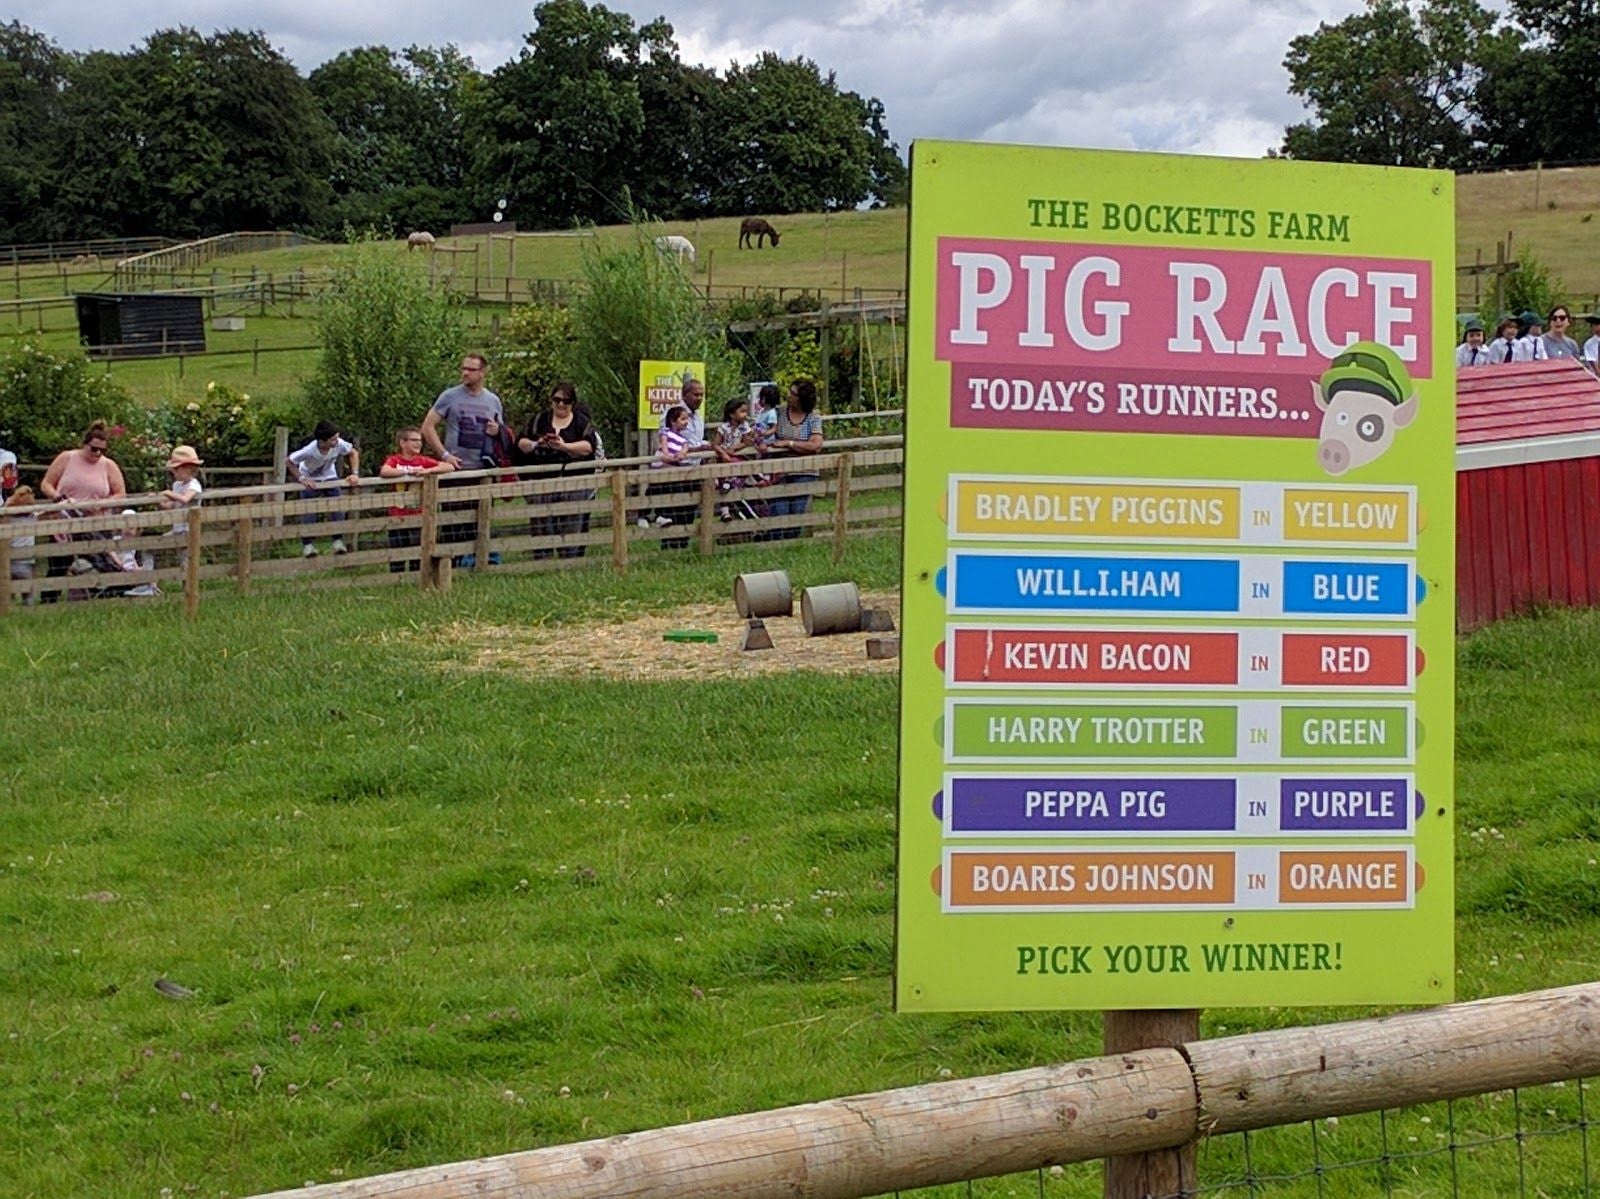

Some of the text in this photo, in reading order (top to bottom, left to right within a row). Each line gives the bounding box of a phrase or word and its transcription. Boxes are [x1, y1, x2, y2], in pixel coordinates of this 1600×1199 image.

[1028, 199, 1350, 242] THE BOCKETTS FARM
[949, 252, 1418, 361] PIG RACE
[648, 388, 681, 400] KITCH
[968, 378, 1310, 421] TODAY'S RUNNERS...
[975, 495, 1398, 530] BRADLEY PIGGINS IN YELLOW
[1016, 568, 1380, 601] WILL.I.HAM IN BLUE
[1005, 642, 1370, 673] KEVIN BACON IN RED
[988, 717, 1386, 745] HARRY TROTTER IN GREEN
[1025, 791, 1395, 818] PEPPA PIG IN PURPLE
[972, 863, 1397, 892] BOARIS JOHNSON IN ORANGE
[1016, 942, 1344, 974] PICK YOUR WINNER!
